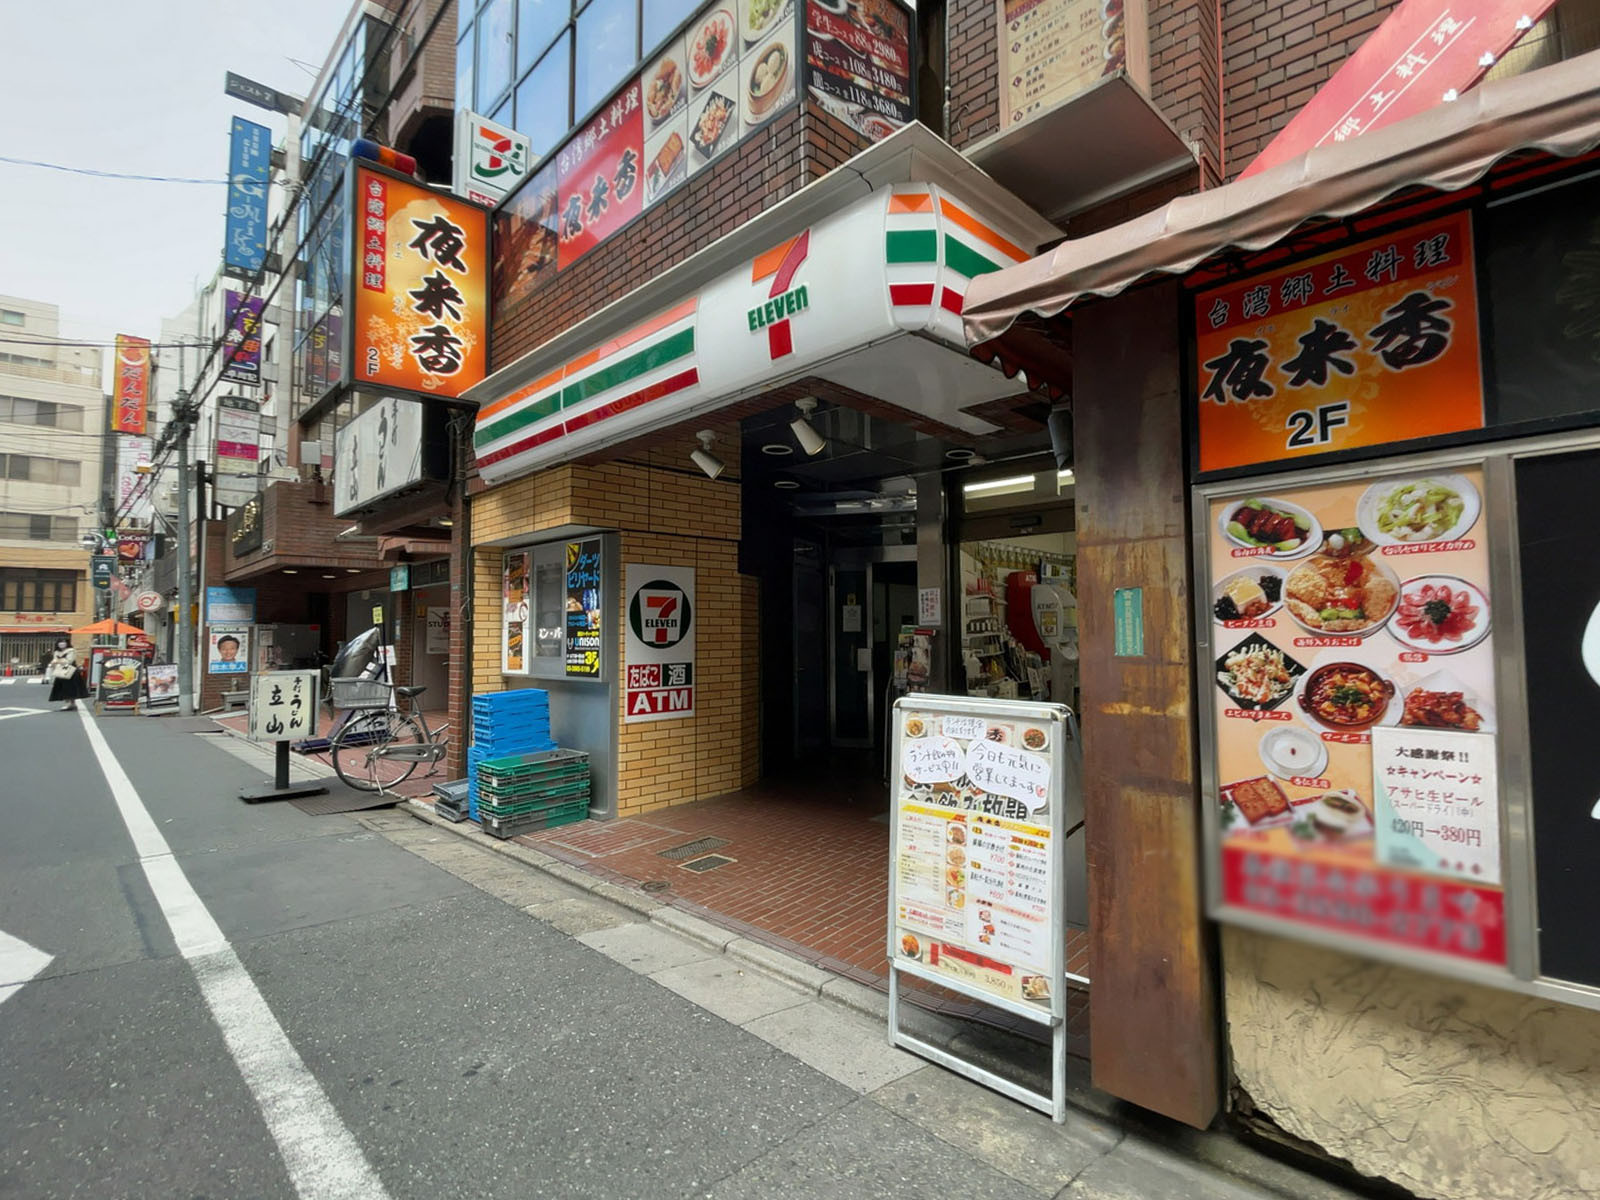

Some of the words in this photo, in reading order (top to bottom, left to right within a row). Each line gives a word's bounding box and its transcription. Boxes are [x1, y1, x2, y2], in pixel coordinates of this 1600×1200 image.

[560, 86, 639, 175] 台湾郷土料理
[560, 147, 638, 243] 夜来香
[408, 215, 467, 376] 夜来香
[1209, 234, 1450, 327] 台湾郷土料理
[367, 348, 379, 376] 2F
[1202, 291, 1456, 404] 夜来香
[121, 367, 142, 425] だんだん
[1286, 403, 1349, 449] 2F
[567, 570, 600, 589] ビリヤード
[579, 552, 600, 571] ダーツ
[585, 651, 598, 665] 3F
[629, 665, 660, 687] たばこ
[668, 664, 687, 686] 酒
[266, 684, 285, 735] 立山
[631, 690, 689, 714] ATM
[971, 742, 1042, 775] 今日も元気に
[1386, 786, 1485, 807] アサヒ生ビール
